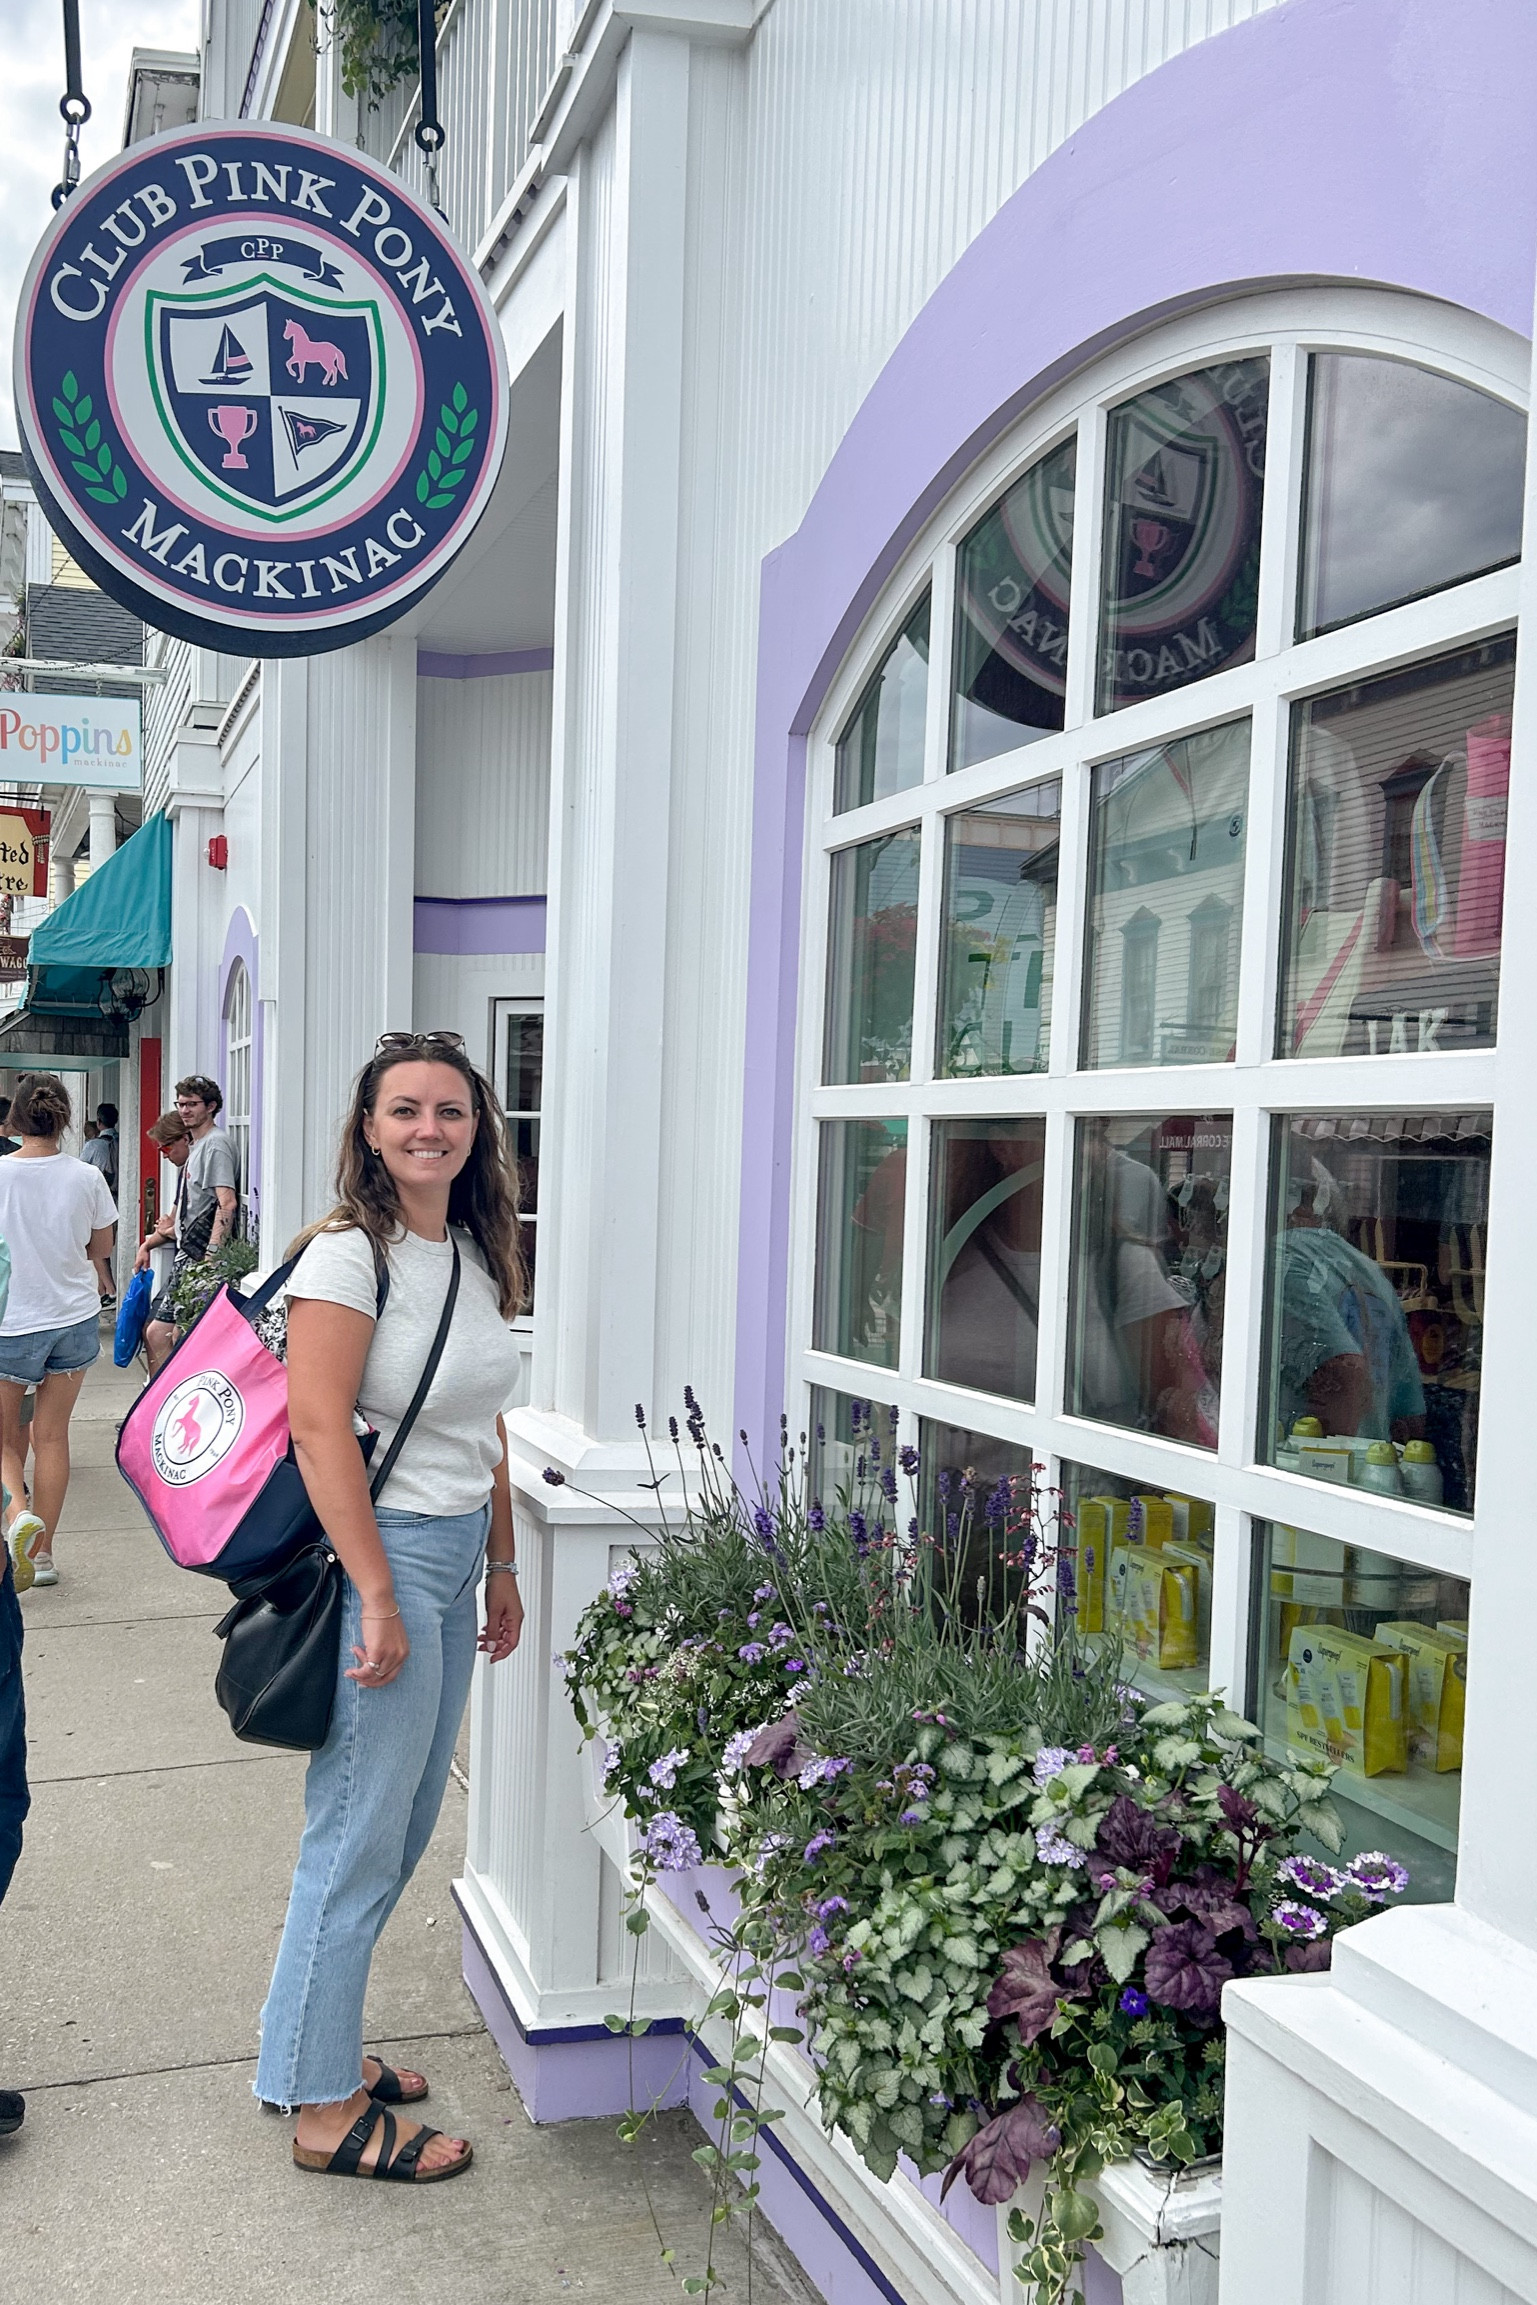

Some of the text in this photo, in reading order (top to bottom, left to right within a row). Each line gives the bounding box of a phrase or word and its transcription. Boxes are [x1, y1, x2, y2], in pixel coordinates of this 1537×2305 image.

[51, 153, 464, 339] CLUB PINK PONY
[120, 498, 428, 600] MACKINAC
[0, 708, 133, 765] Poppins
[74, 758, 128, 768] mackinac
[197, 1376, 237, 1426] PINK PONY
[154, 1433, 187, 1480] MACKINAC
